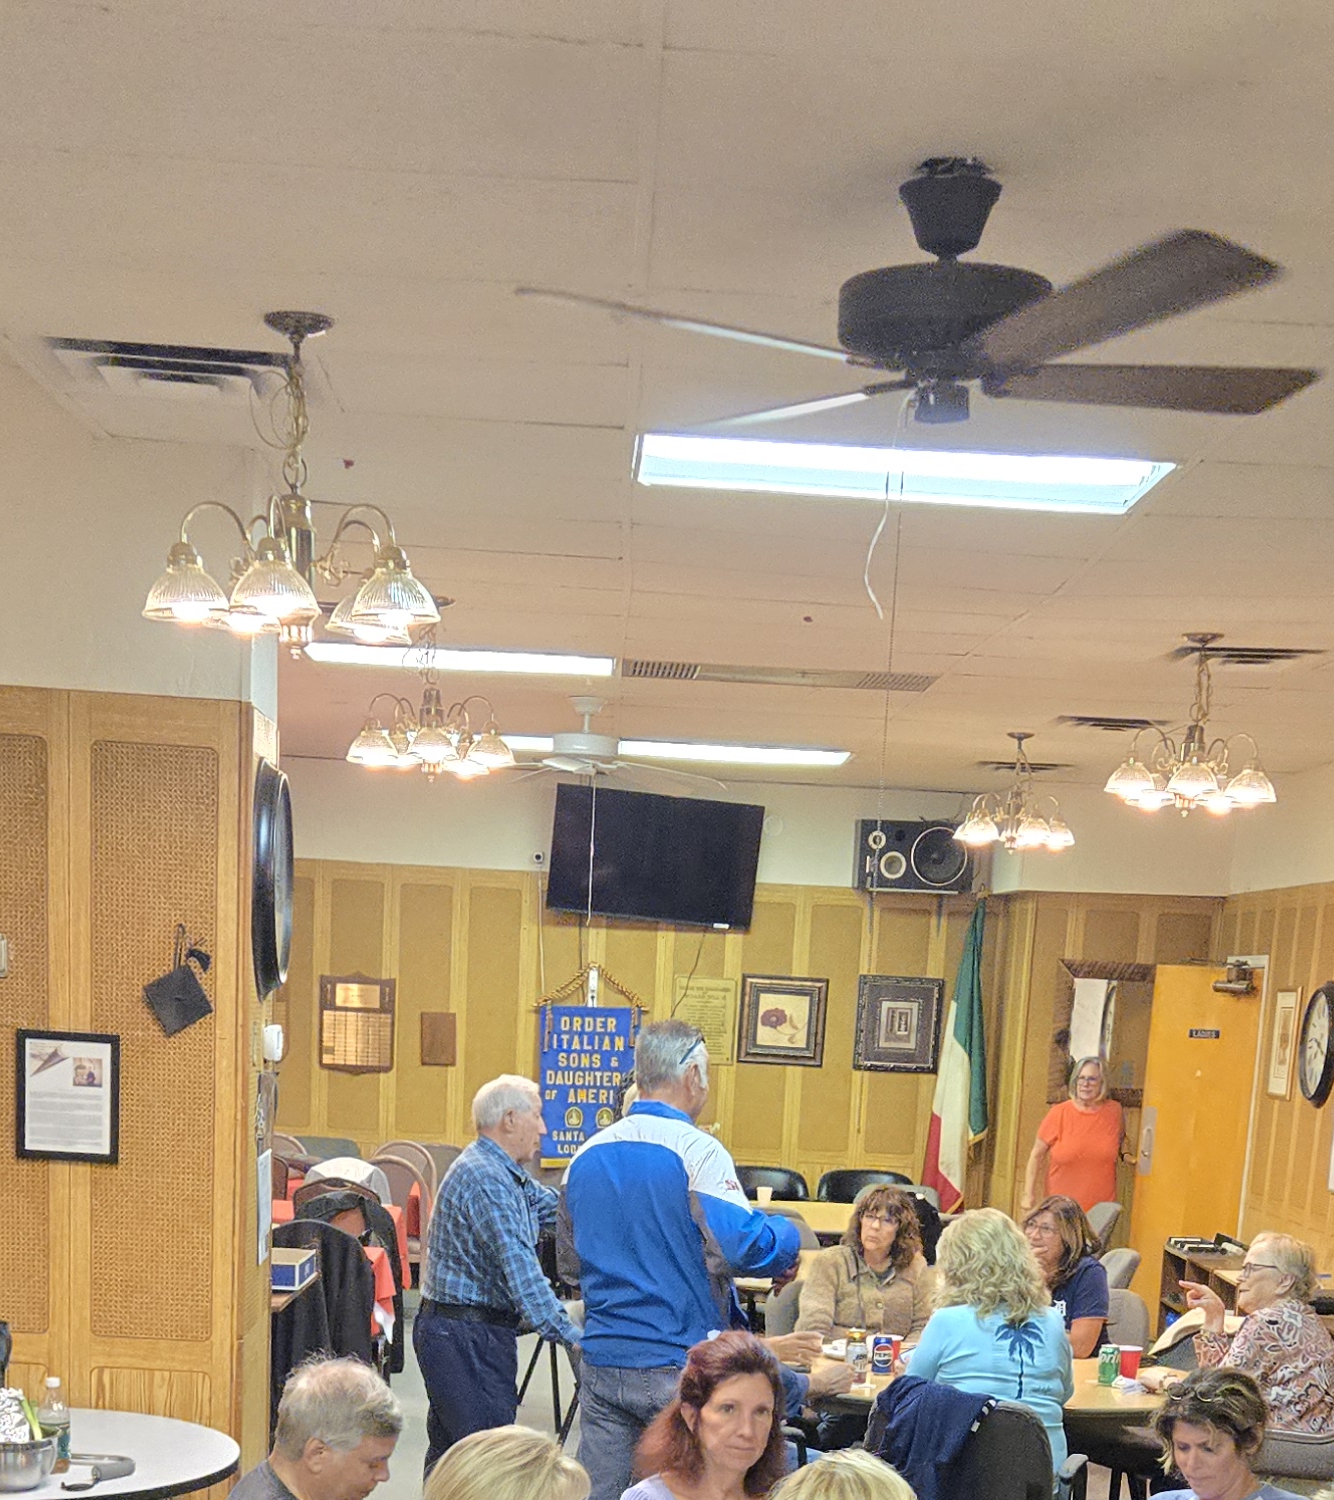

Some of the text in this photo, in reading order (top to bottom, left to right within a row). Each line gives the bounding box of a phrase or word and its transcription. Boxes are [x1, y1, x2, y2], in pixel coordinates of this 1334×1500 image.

[560, 1016, 617, 1033] ORDER
[552, 1034, 625, 1051] ITALIAN
[558, 1053, 619, 1068] SONS &
[546, 1070, 624, 1087] DAUGHTER
[545, 1088, 614, 1104] OF AMERI
[552, 1130, 586, 1142] SANTA
[557, 1144, 581, 1154] LOD
